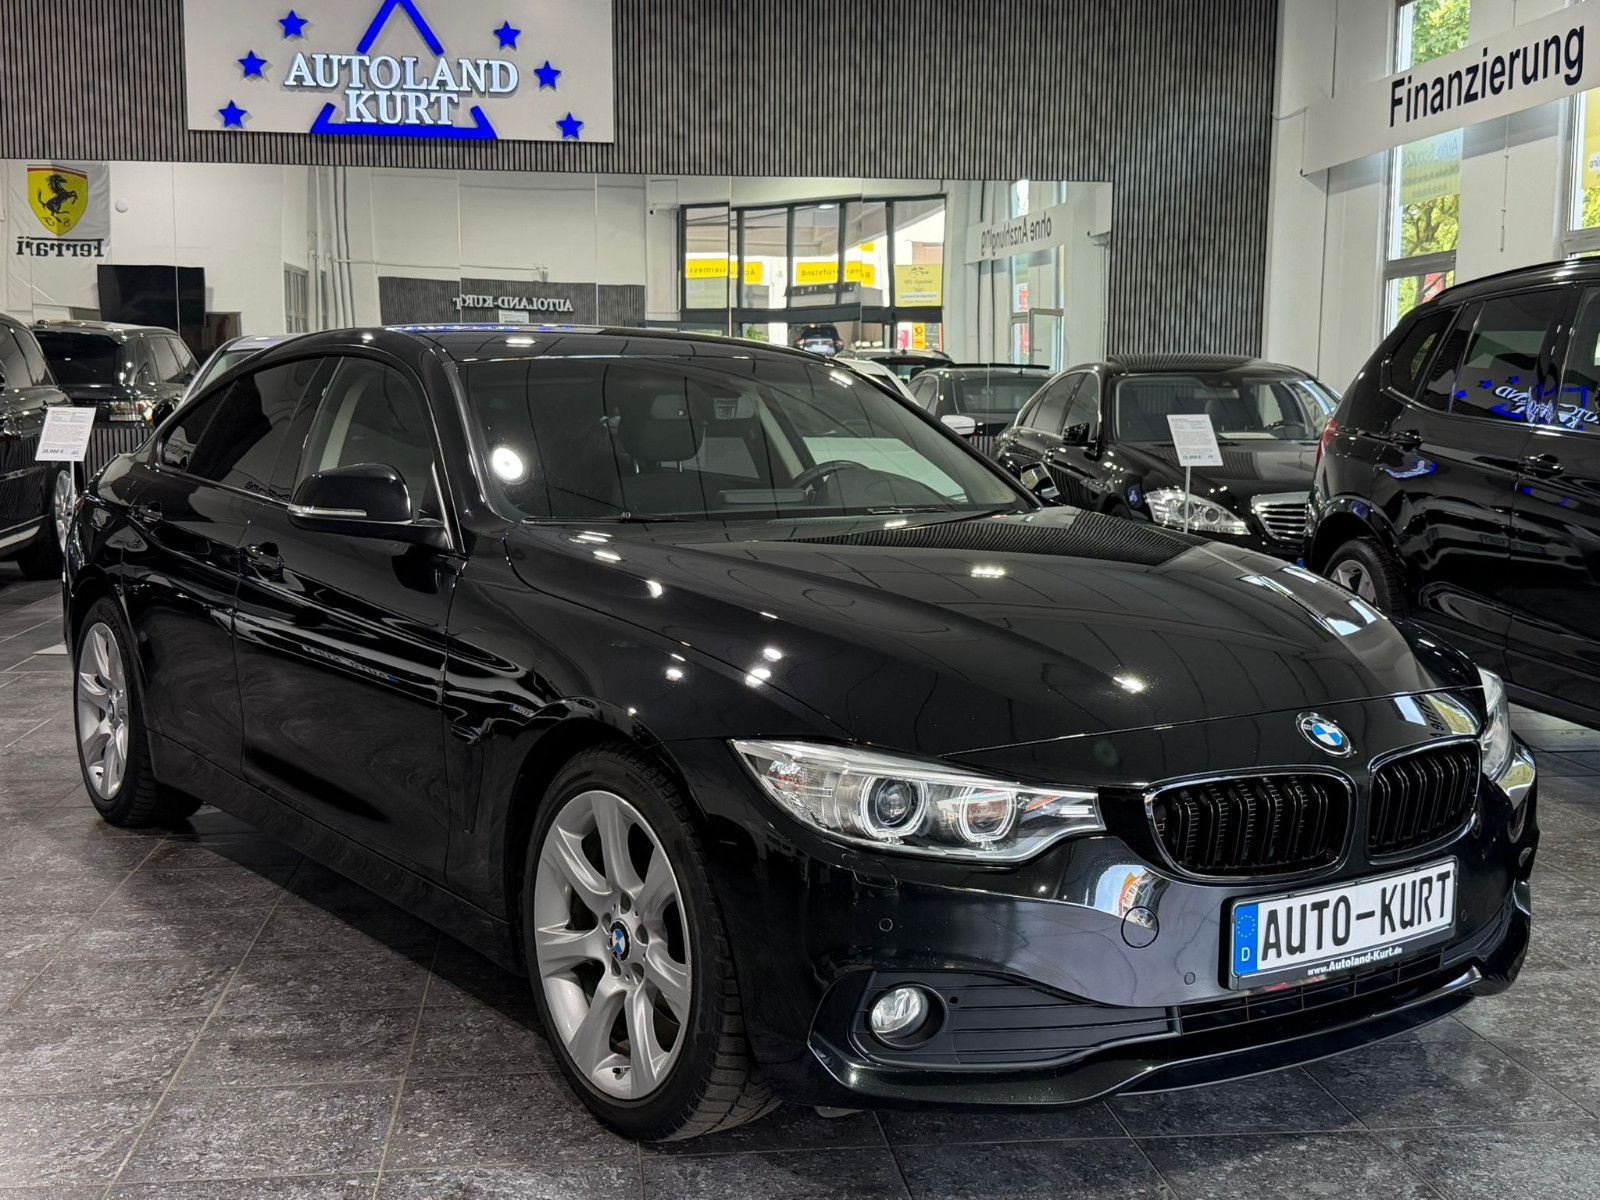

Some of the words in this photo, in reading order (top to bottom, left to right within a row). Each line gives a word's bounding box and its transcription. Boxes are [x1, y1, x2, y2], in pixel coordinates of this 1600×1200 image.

[284, 52, 519, 93] AUTOLAND
[1389, 25, 1585, 128] Finanzierung
[345, 89, 459, 125] KURT
[1261, 870, 1451, 962] AUTO-KURT
[1241, 946, 1251, 962] D
[1307, 946, 1403, 976] www.Autoland-Kurt.de
